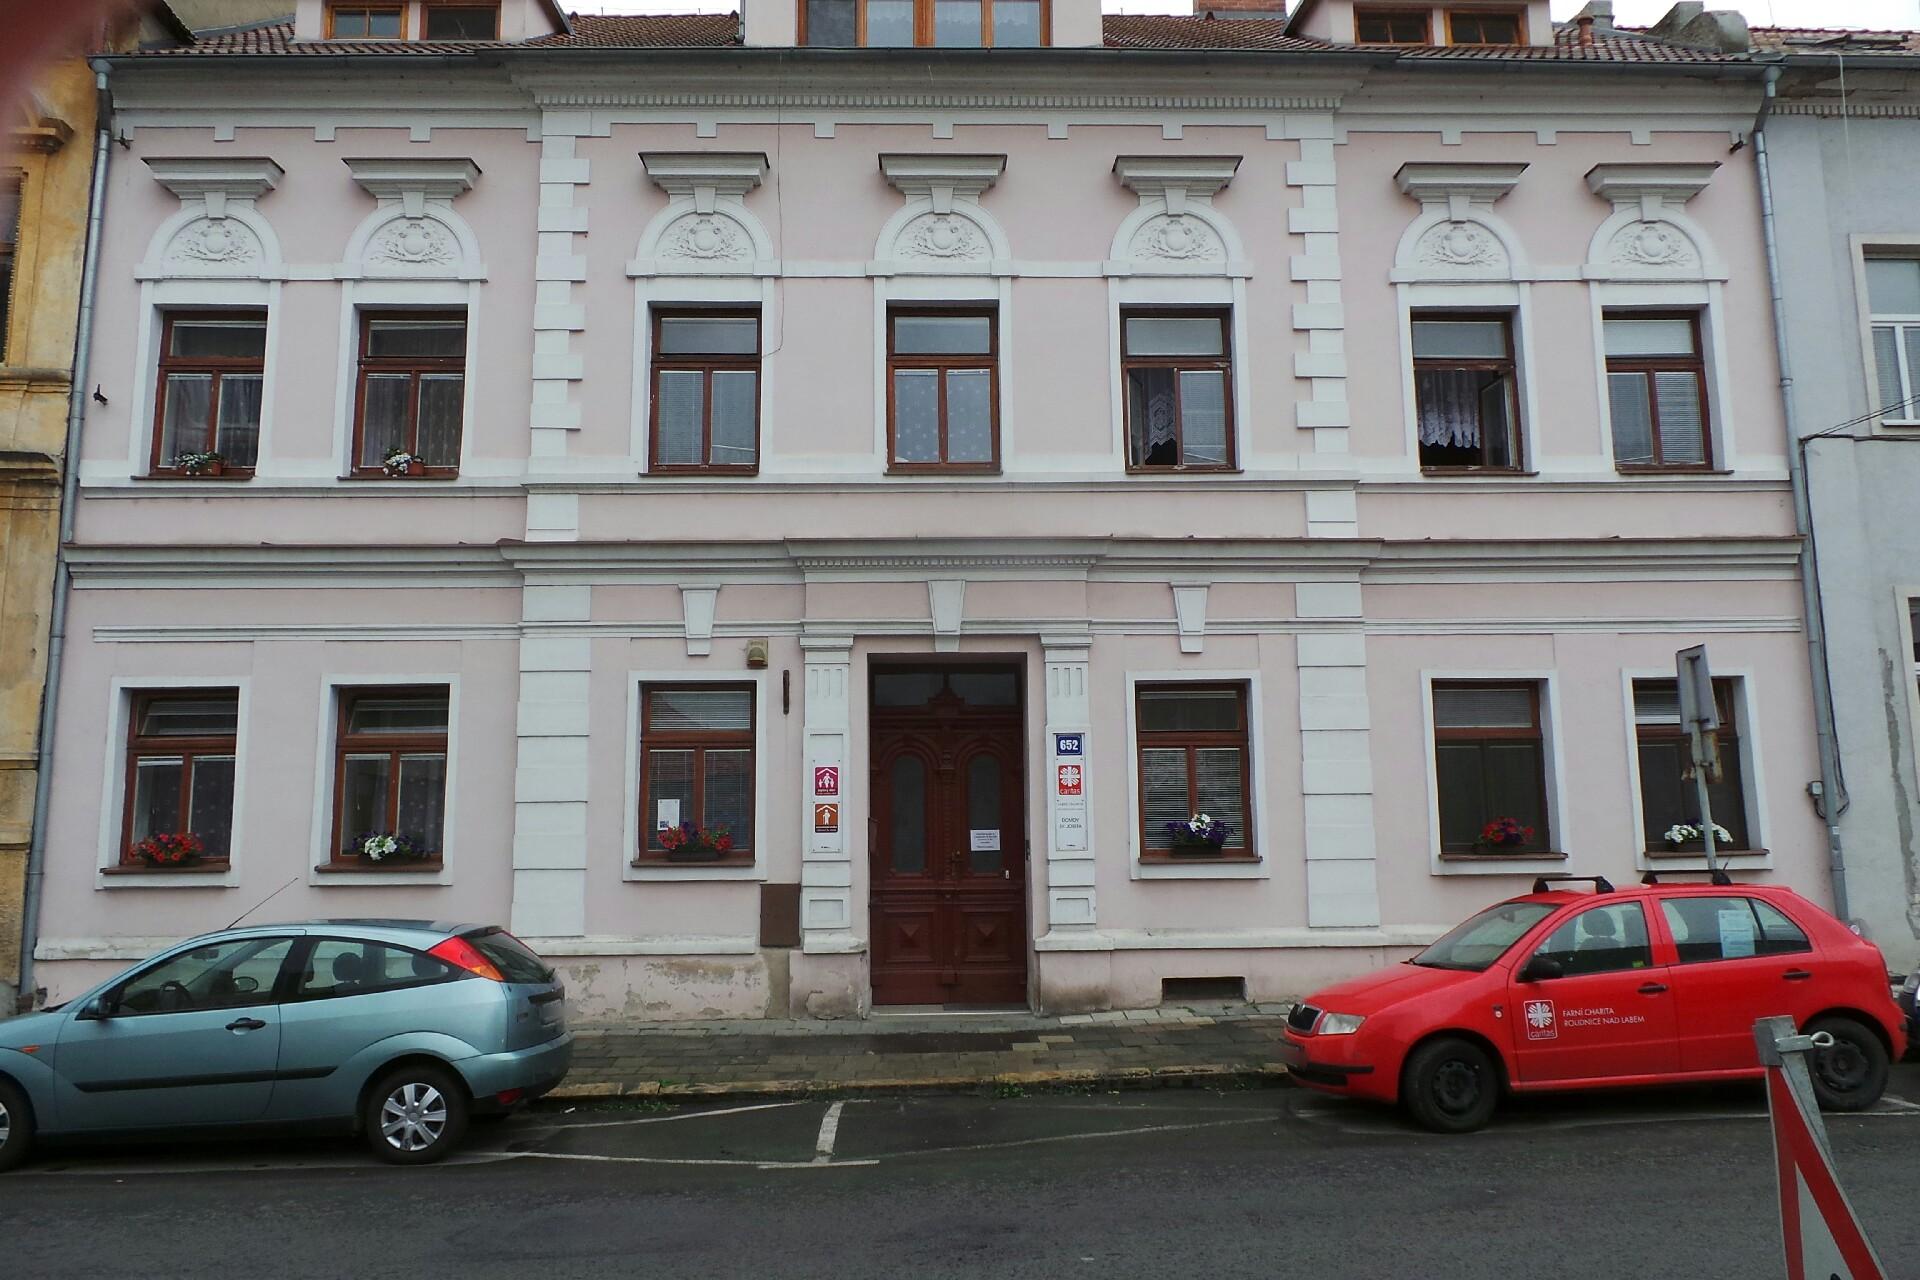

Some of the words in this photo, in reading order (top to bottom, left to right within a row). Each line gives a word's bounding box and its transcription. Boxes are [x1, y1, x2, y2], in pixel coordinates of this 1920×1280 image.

[1060, 739, 1078, 750] 652
[1562, 1007, 1583, 1017] FARNÍ
[1584, 1007, 1614, 1016] CHARITA
[1564, 1017, 1601, 1027] ROUDNICE
[1621, 1015, 1645, 1024] LABEM
[1530, 1029, 1555, 1038] caritas
